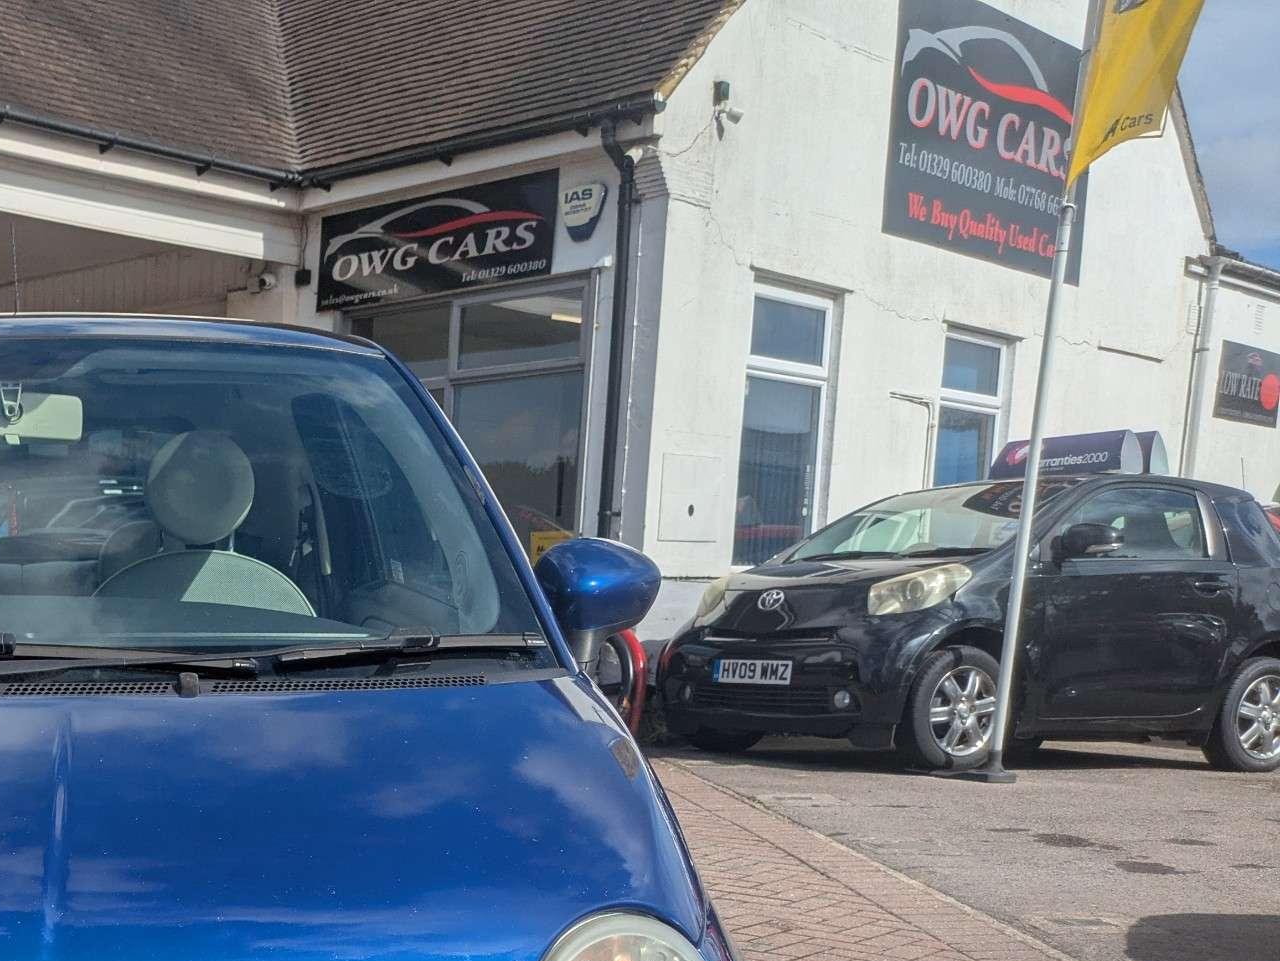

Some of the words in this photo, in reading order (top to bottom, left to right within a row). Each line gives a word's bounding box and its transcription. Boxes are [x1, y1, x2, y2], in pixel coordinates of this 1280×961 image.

[908, 78, 990, 149] OWG
[1120, 113, 1153, 131] Cars
[898, 142, 917, 169] Tel:
[918, 150, 951, 180] 01329
[951, 161, 993, 193] 600380
[994, 175, 1017, 202] Mob:
[1017, 184, 1047, 212] 07768
[564, 188, 593, 204] IAS
[907, 191, 929, 222] We
[931, 199, 958, 241] Buy
[959, 208, 1008, 255] Quality
[1008, 223, 1040, 254] Used
[1039, 233, 1057, 257] Ca
[331, 242, 419, 282] OWG
[428, 221, 538, 265] CARS
[507, 259, 547, 275] 600380
[1040, 452, 1108, 467] arranties2000
[721, 662, 757, 679] HV09
[760, 662, 789, 680] WMZ
